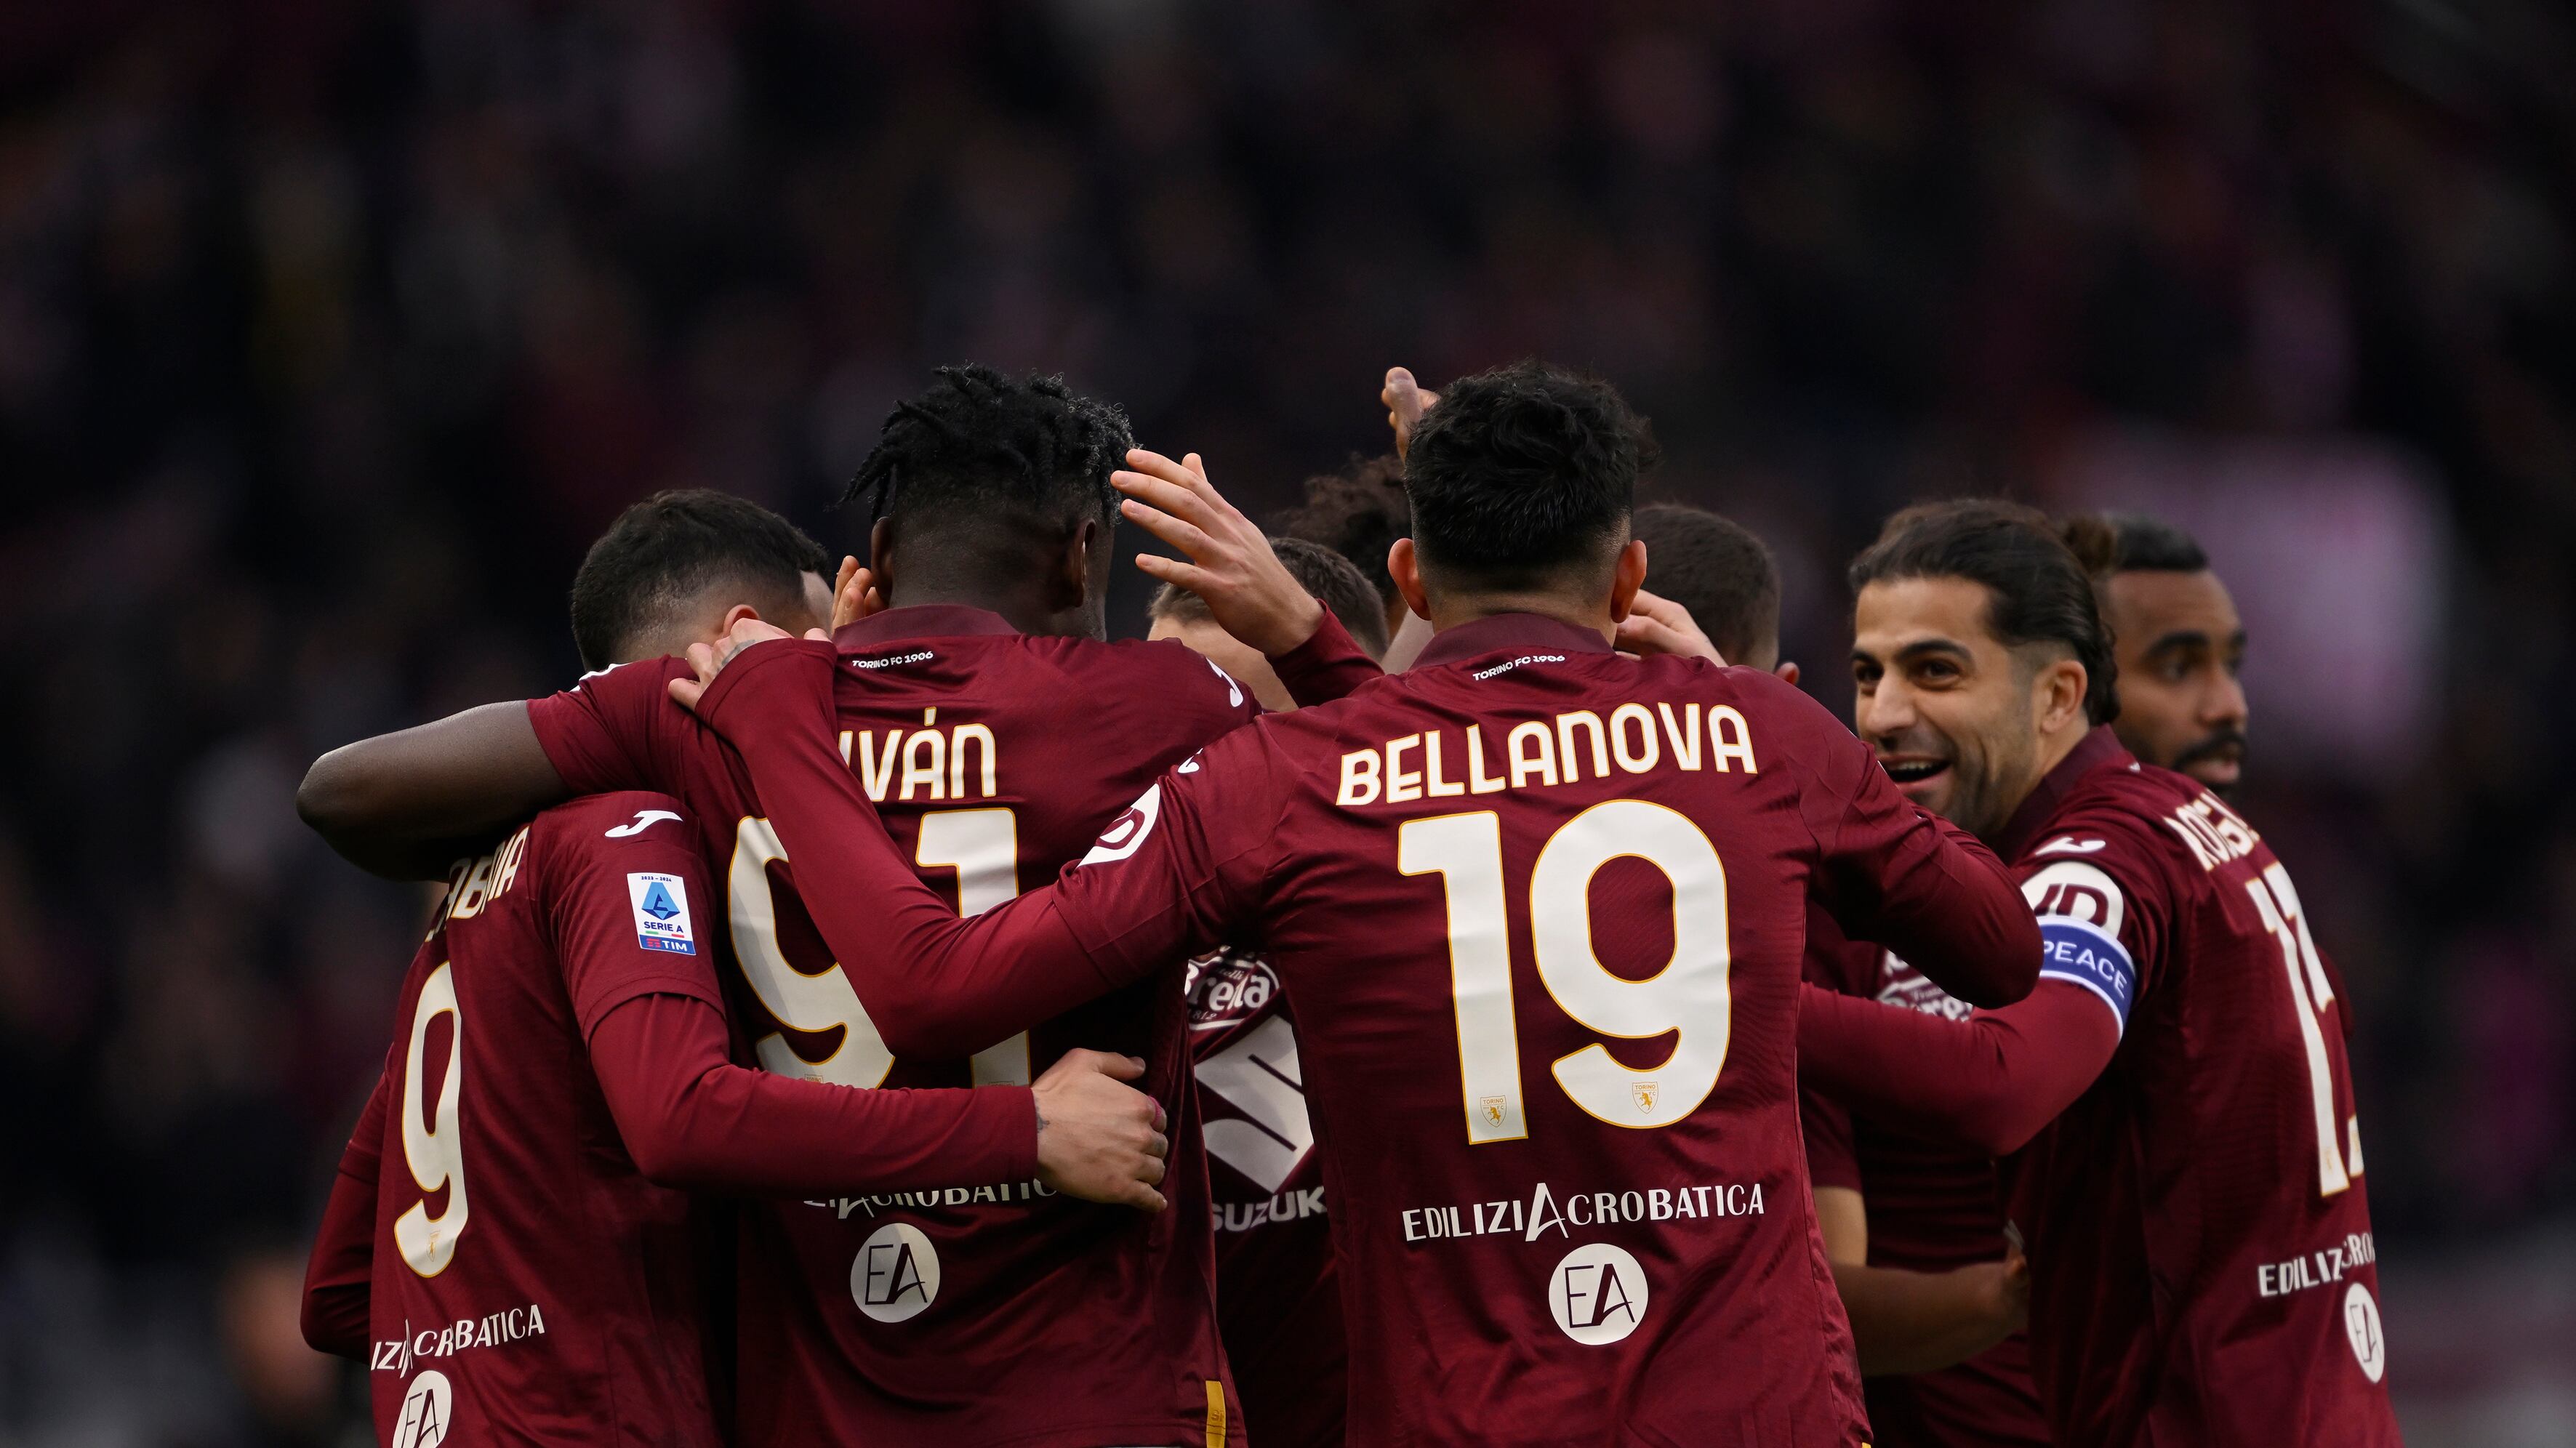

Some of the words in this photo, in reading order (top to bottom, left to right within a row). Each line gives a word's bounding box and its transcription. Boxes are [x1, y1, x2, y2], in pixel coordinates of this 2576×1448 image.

[852, 659, 889, 669] TORINO
[890, 656, 903, 665] FC
[904, 651, 934, 663] 1906
[1472, 661, 1513, 681] TORINO
[1514, 656, 1531, 667] FC
[1336, 702, 1758, 806] BELLANOVA
[643, 921, 674, 931] SERIE
[676, 925, 684, 933] A
[661, 940, 688, 952] TIM
[1397, 798, 1732, 1146] 19
[393, 960, 469, 1279] 9
[864, 1243, 928, 1306] EA
[1564, 1263, 1636, 1329] EA
